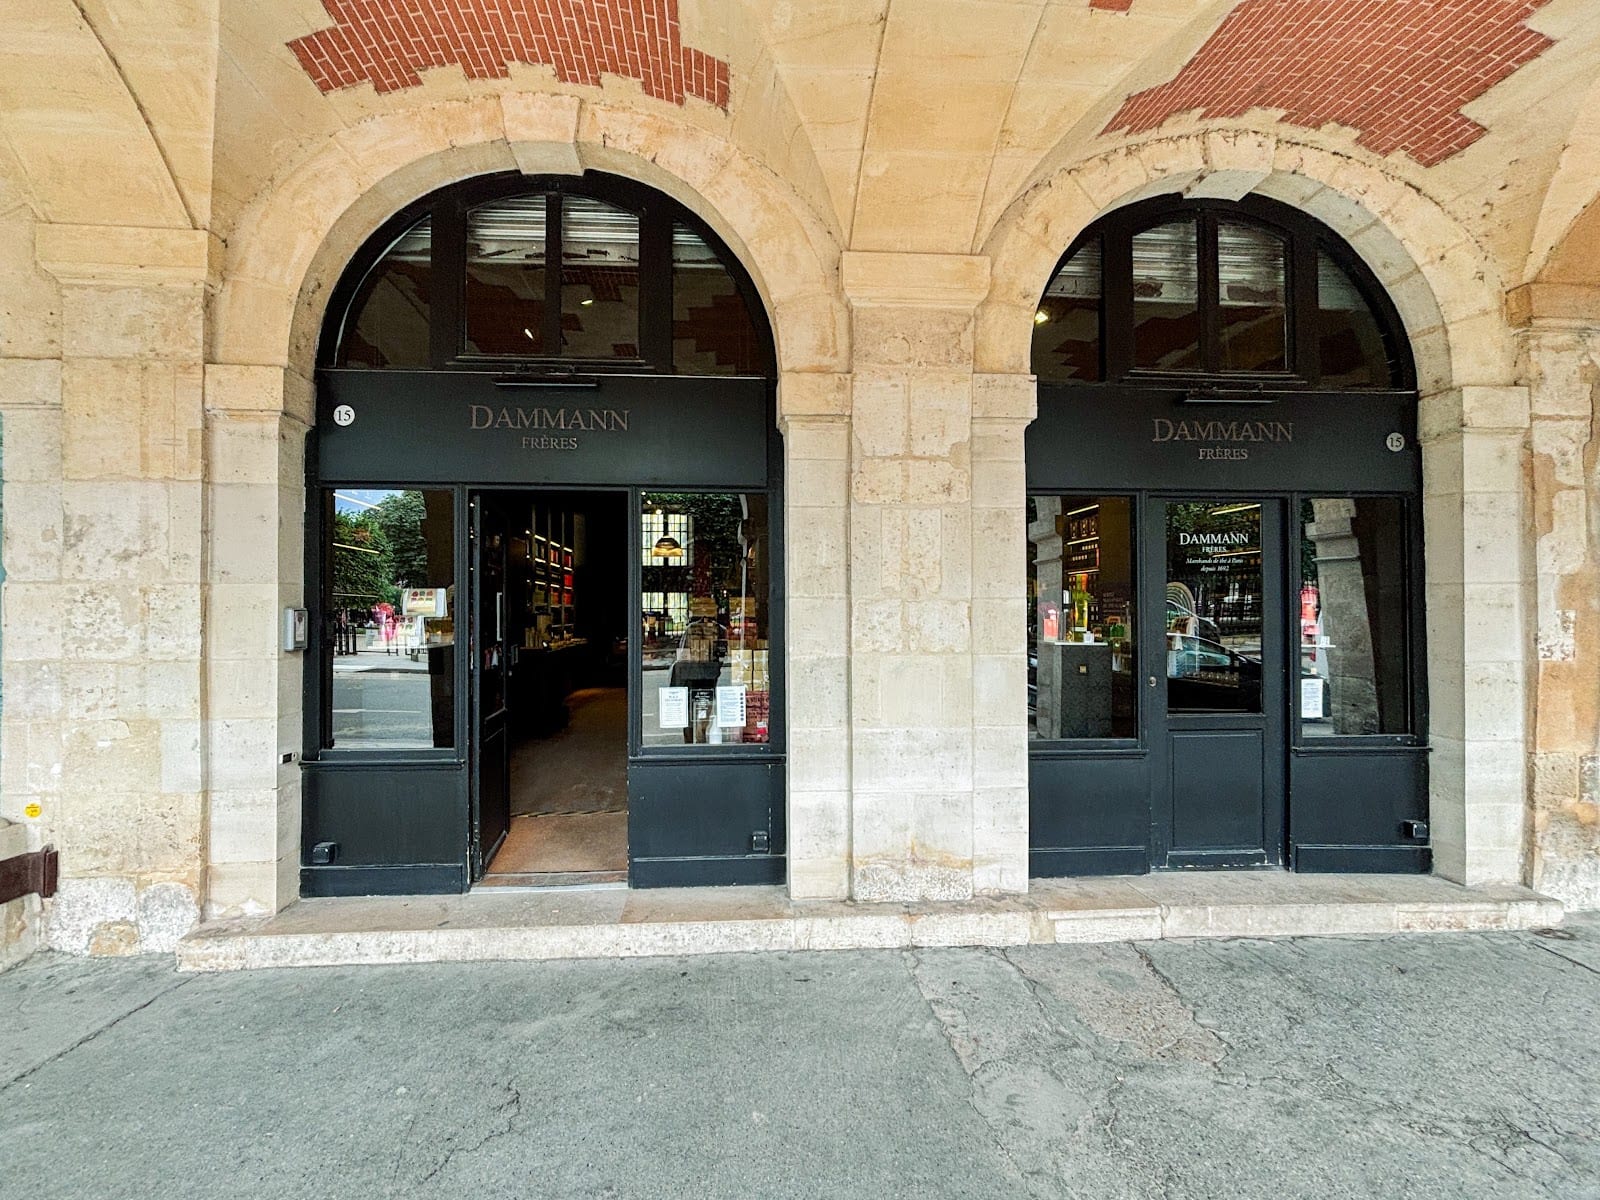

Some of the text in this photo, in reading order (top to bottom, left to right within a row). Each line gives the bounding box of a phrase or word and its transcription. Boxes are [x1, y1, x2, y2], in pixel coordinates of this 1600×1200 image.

[335, 410, 352, 422] 15
[469, 404, 631, 431] DAMMANN
[1152, 418, 1294, 442] DAMMANN
[521, 434, 578, 450] FRÈRES
[1389, 436, 1403, 448] 15
[1198, 446, 1249, 460] FRÈRES
[1180, 532, 1249, 545] DAMMANN
[1202, 545, 1227, 553] FRÈRES
